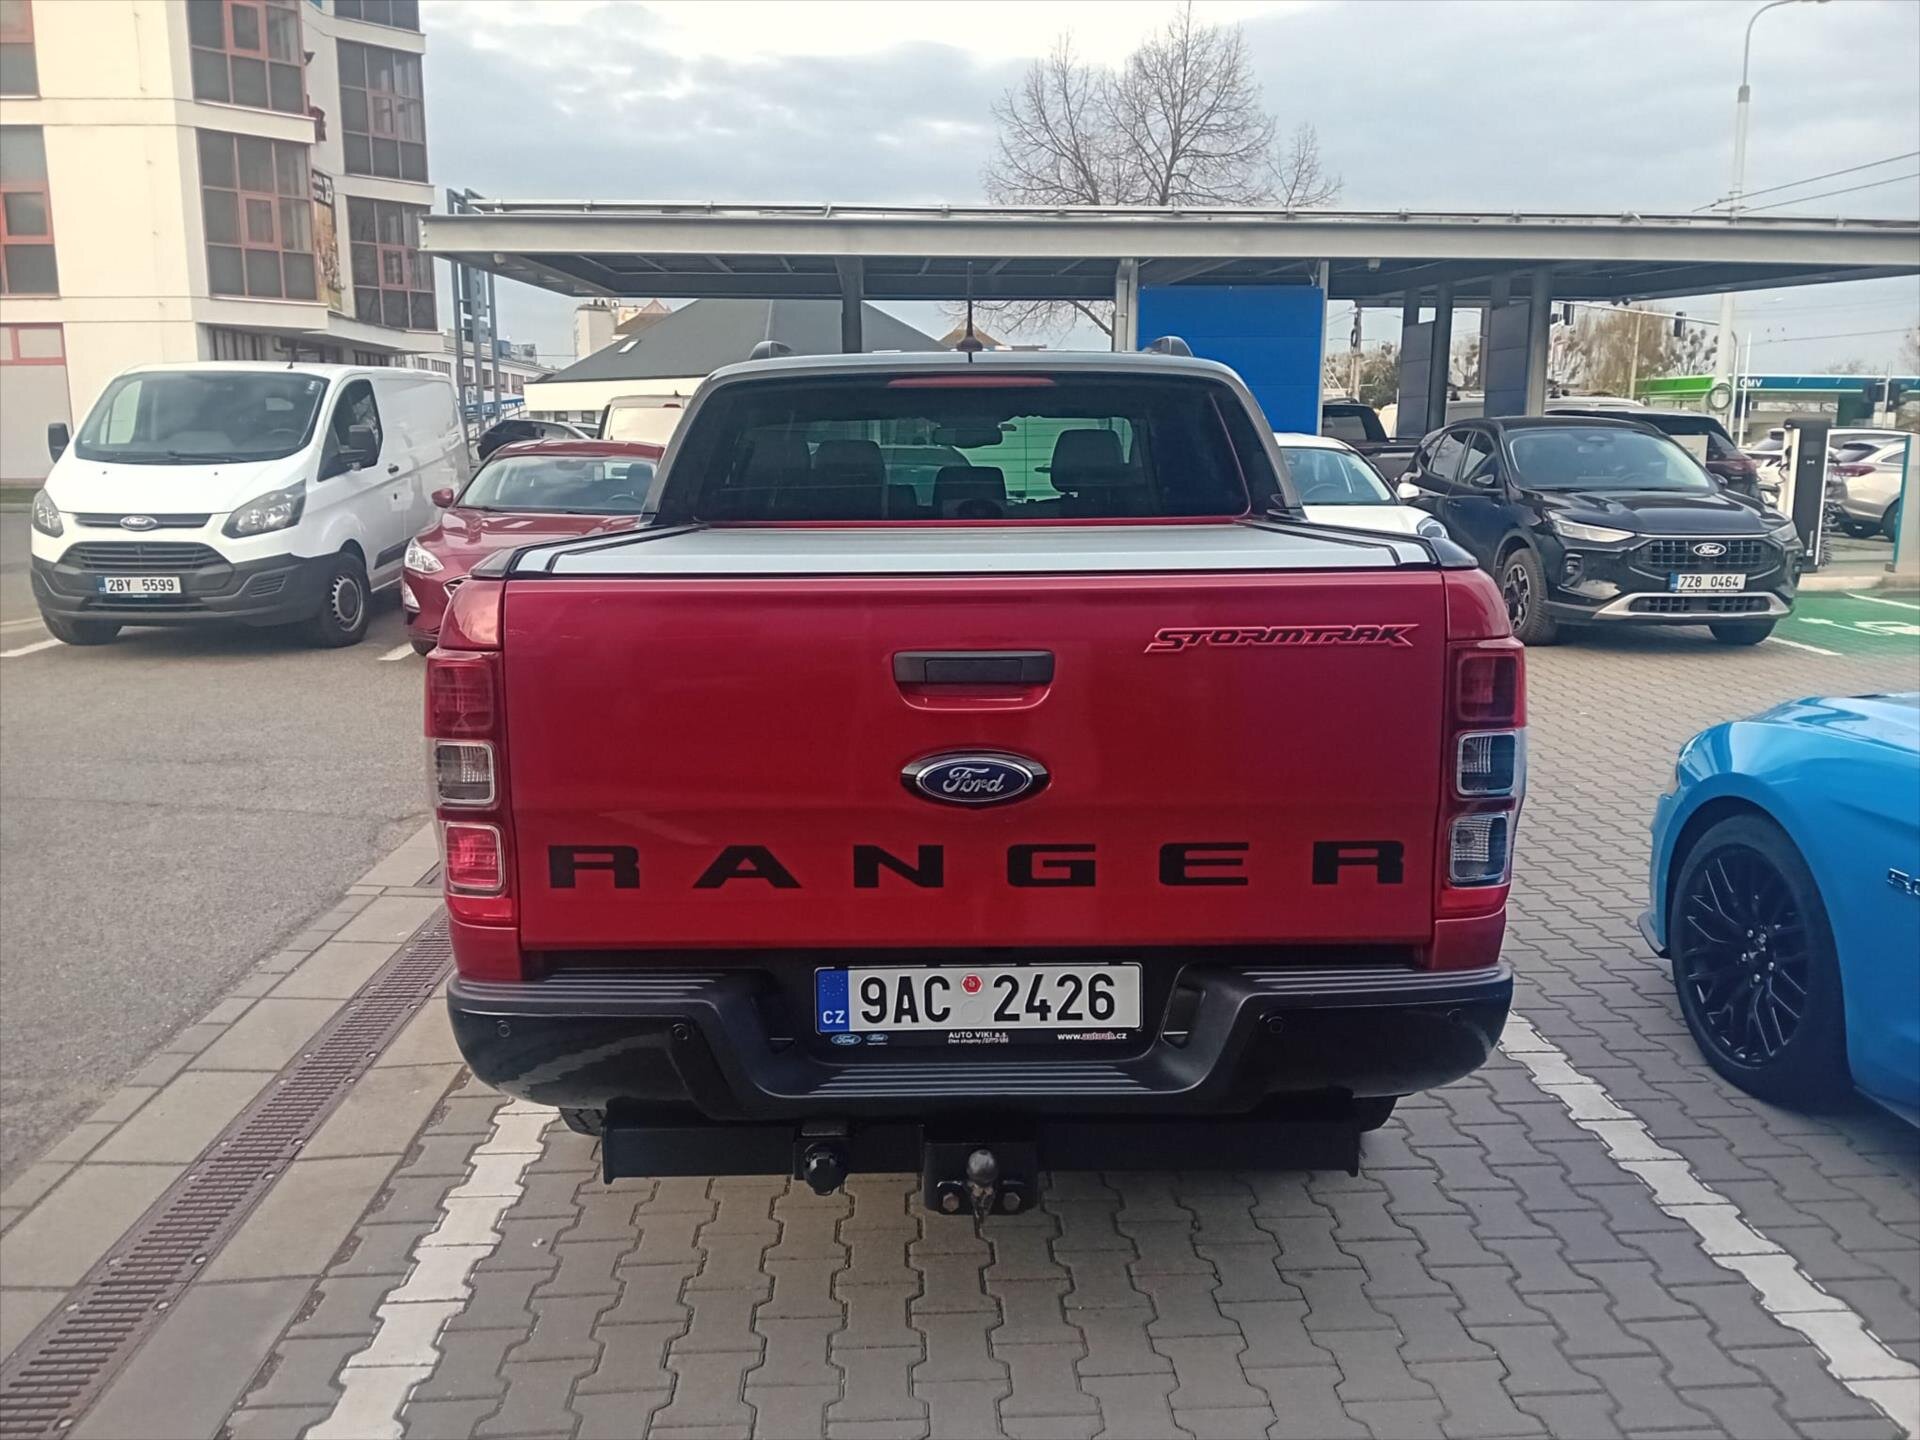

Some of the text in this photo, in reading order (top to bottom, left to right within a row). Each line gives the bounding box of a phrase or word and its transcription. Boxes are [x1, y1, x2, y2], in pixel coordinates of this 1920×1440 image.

[1740, 378, 1763, 388] OMV
[107, 578, 131, 592] 2BY
[141, 578, 174, 592] 5599
[1680, 575, 1739, 588] 7Z8 0464
[1144, 624, 1418, 653] STORMTRAK
[942, 766, 1006, 793] Ford
[549, 840, 1404, 889] RANGER
[860, 972, 1115, 1024] 9AC 2426
[822, 1010, 846, 1024] CZ
[948, 1031, 973, 1039] AUTO
[975, 1031, 993, 1039] VIKI
